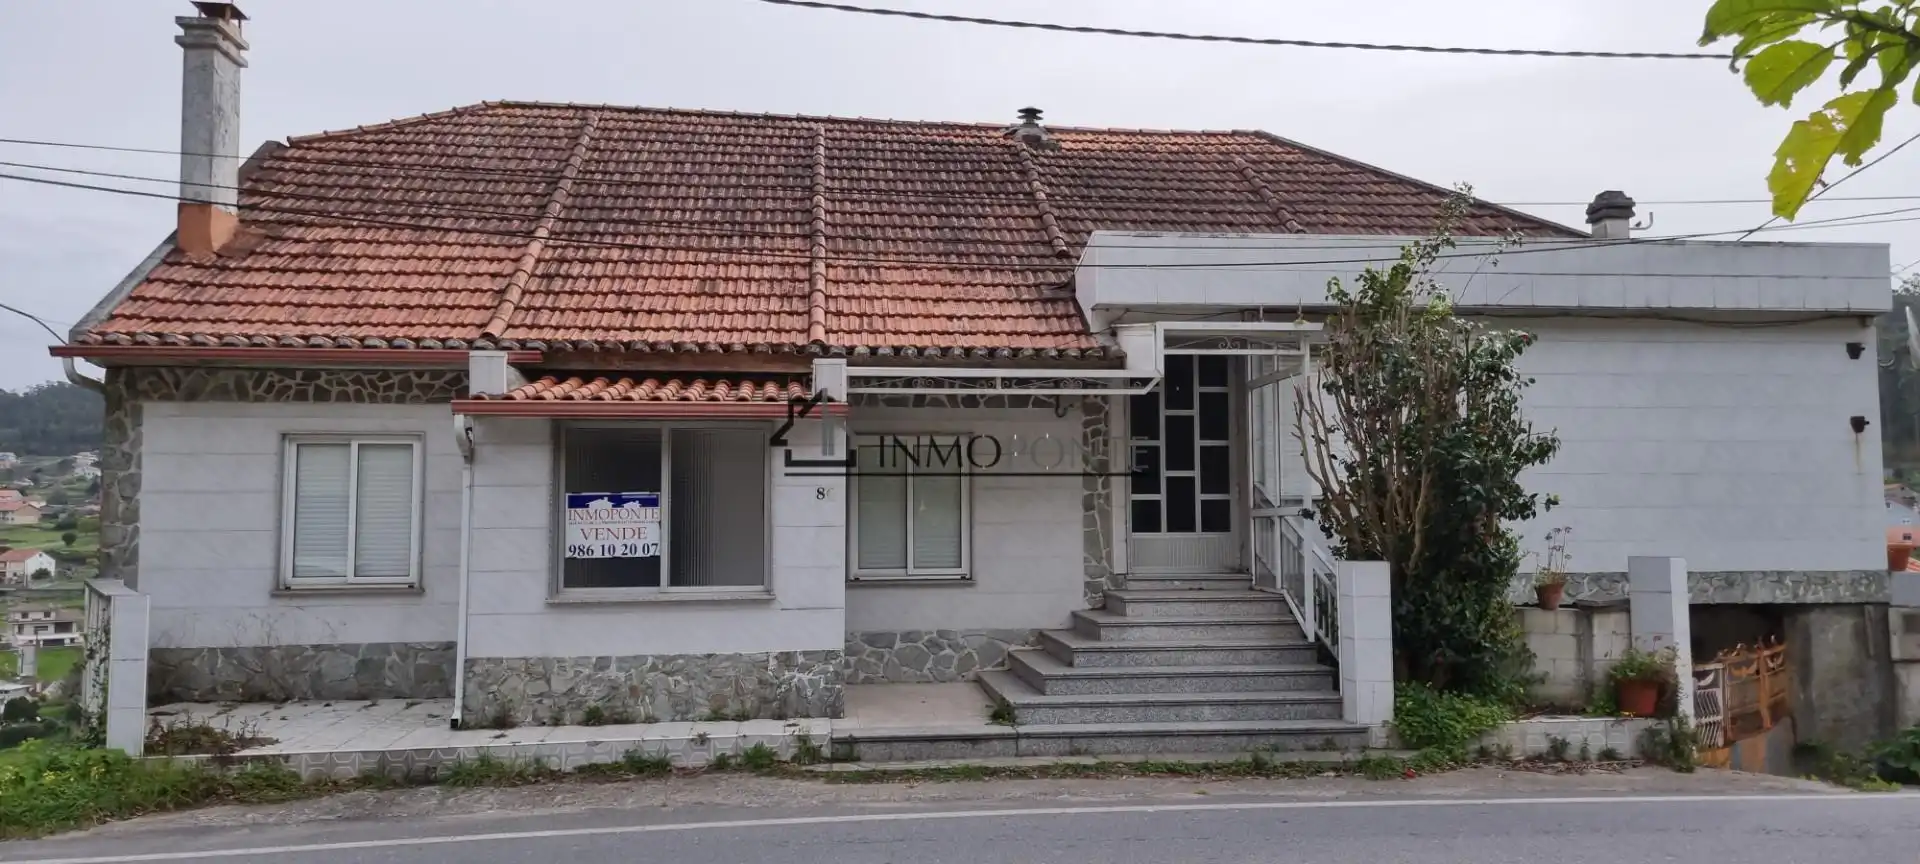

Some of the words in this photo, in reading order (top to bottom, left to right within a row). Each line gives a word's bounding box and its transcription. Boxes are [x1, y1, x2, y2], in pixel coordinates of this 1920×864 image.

[568, 508, 659, 520] INMOPONTE
[580, 527, 648, 540] VENDE
[568, 544, 594, 557] 986
[600, 544, 616, 556] 10
[621, 543, 638, 556] 20
[642, 543, 658, 556] 07
